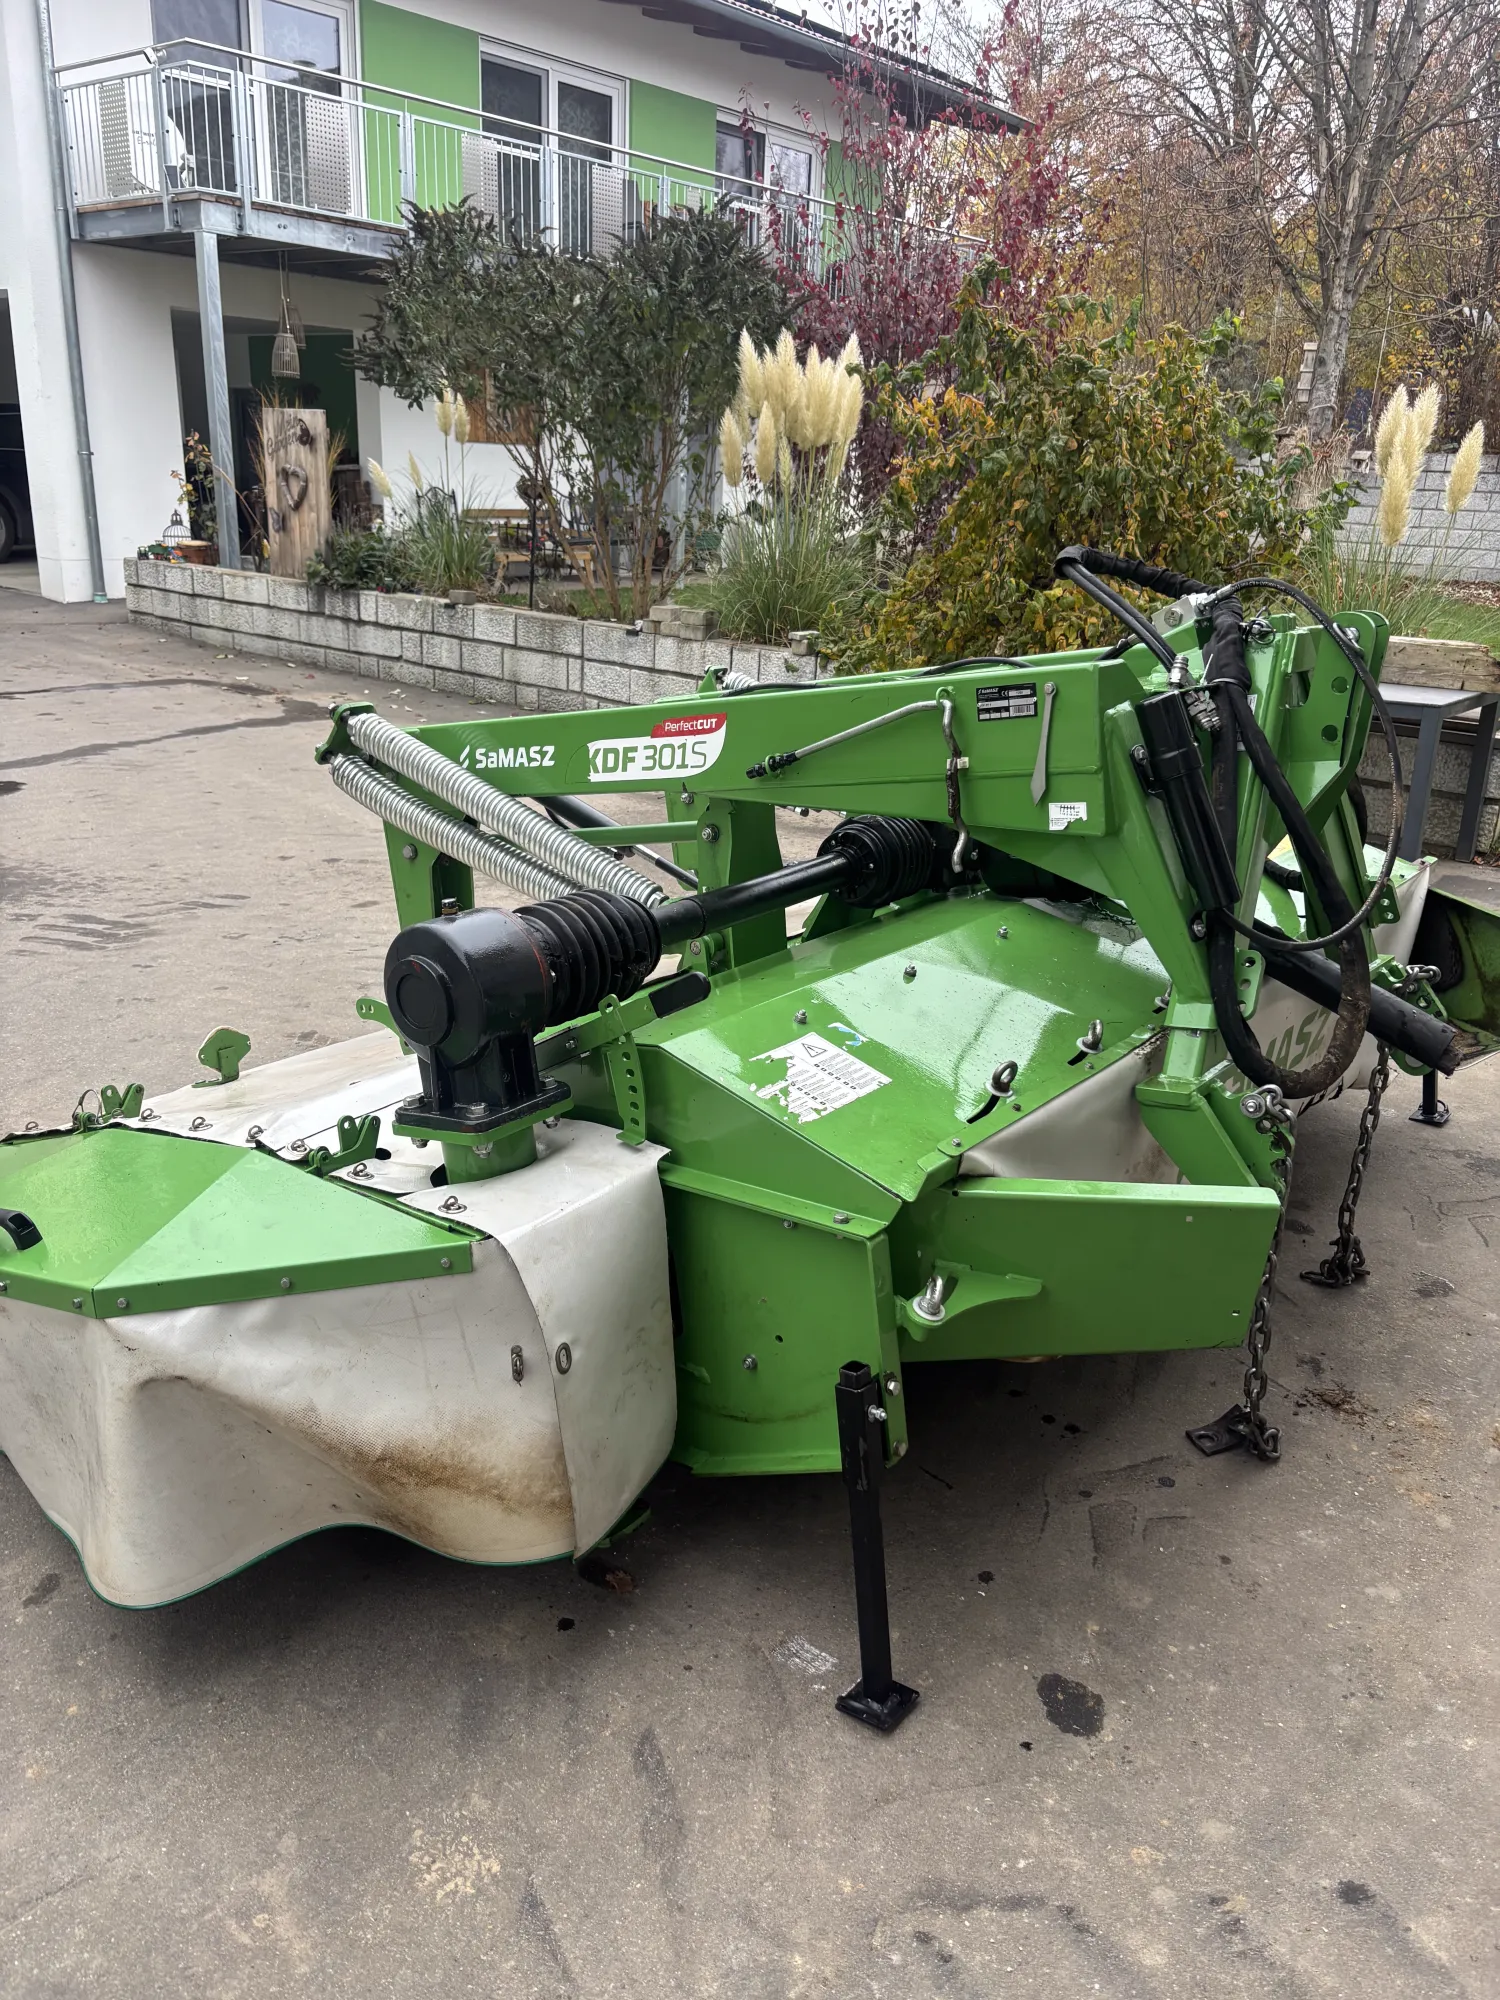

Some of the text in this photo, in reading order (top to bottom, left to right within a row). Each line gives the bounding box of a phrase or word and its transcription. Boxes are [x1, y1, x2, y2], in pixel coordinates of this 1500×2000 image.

[664, 718, 718, 732] PerfectCUT
[475, 745, 556, 769] SaMASZ
[588, 740, 707, 774] KDF 301S
